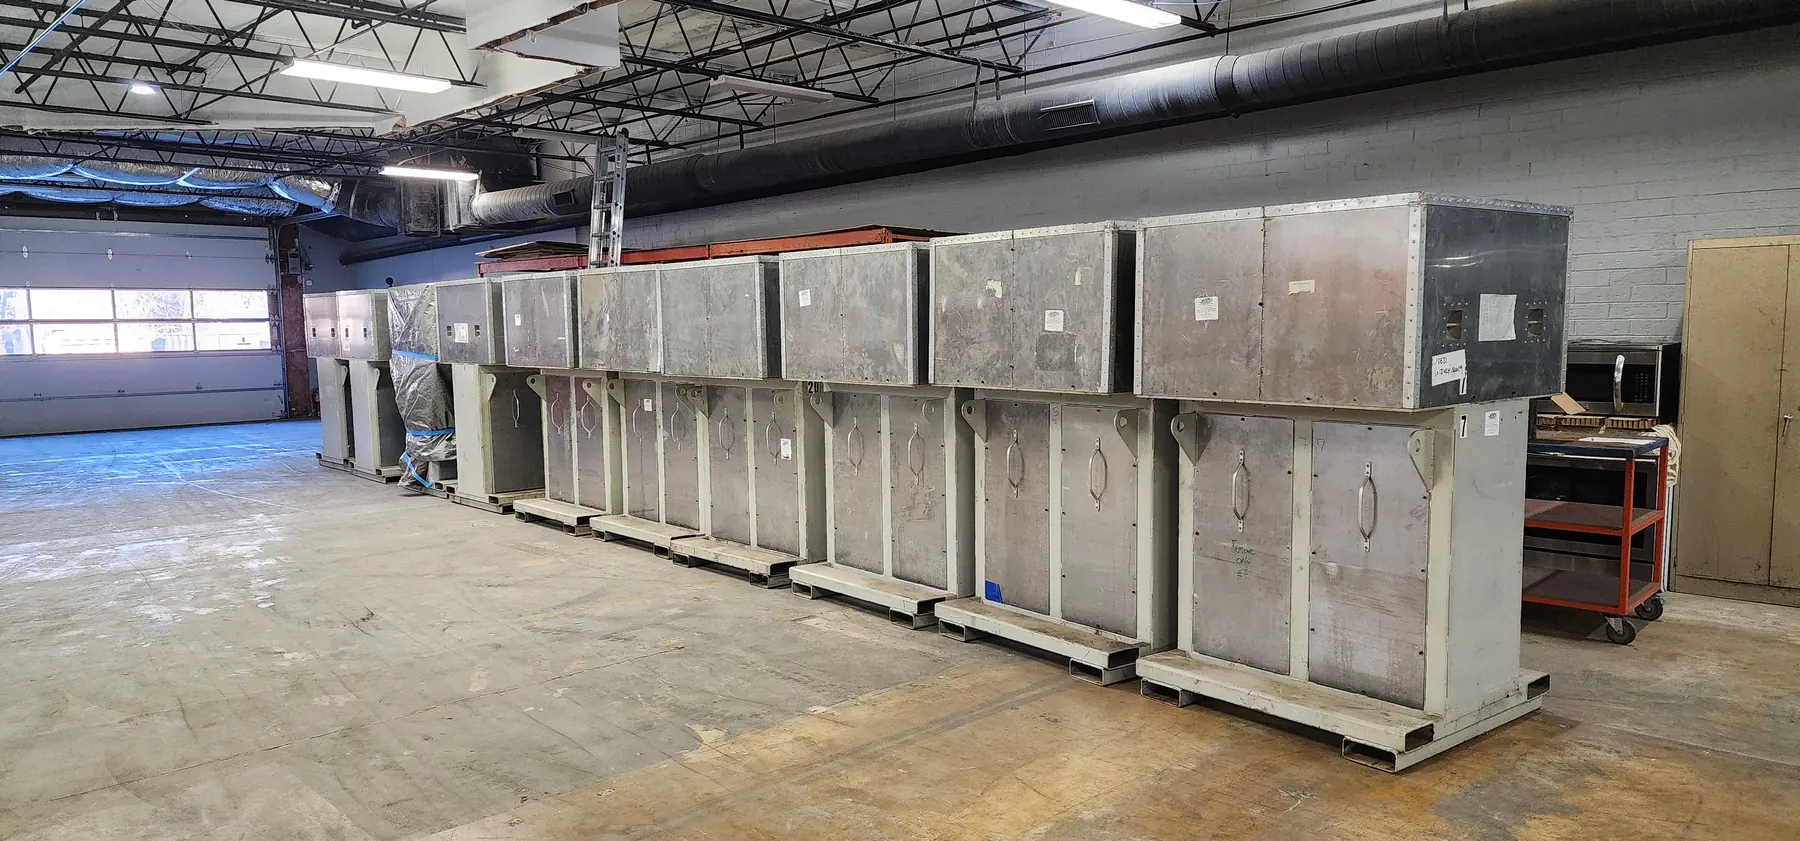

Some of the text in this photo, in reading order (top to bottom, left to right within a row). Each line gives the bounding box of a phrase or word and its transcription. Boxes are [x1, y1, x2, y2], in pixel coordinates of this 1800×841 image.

[808, 381, 819, 393] 20
[1052, 406, 1060, 417] 5
[1461, 415, 1467, 437] 7
